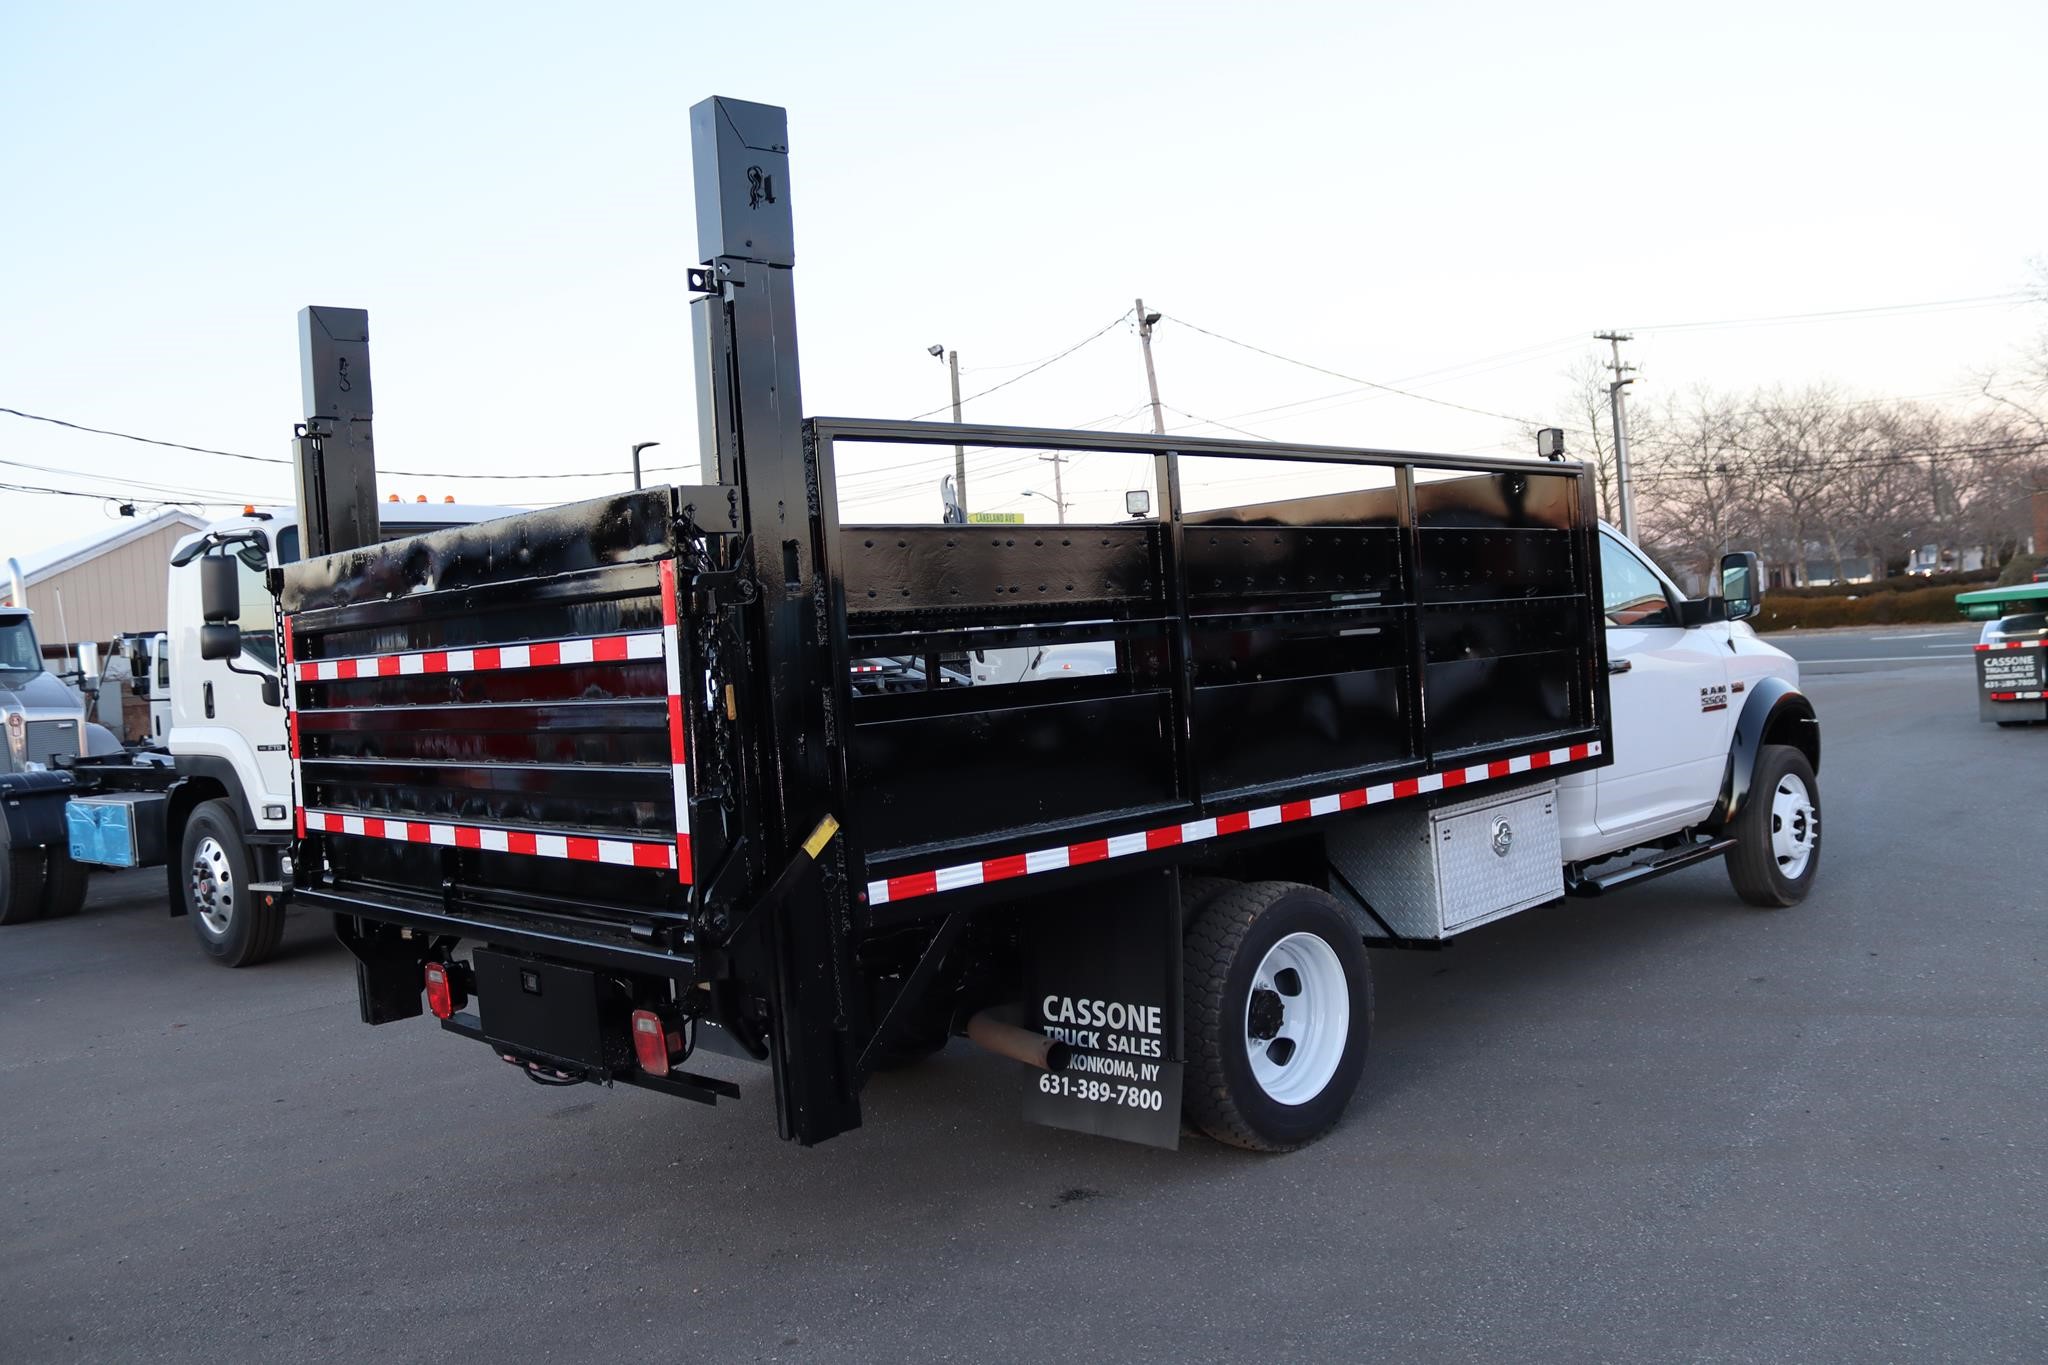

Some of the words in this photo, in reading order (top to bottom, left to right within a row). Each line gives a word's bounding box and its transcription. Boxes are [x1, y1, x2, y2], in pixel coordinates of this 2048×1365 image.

[1984, 655, 2035, 667] CASSONE
[1701, 685, 1727, 696] RAM
[1043, 995, 1161, 1034] CASSONE
[1044, 1026, 1100, 1049] TRUCK
[1107, 1034, 1161, 1057] SALES
[1067, 1053, 1138, 1081] KONKOMA,
[1141, 1063, 1160, 1082] NY
[1039, 1073, 1162, 1111] 631-389-7800
